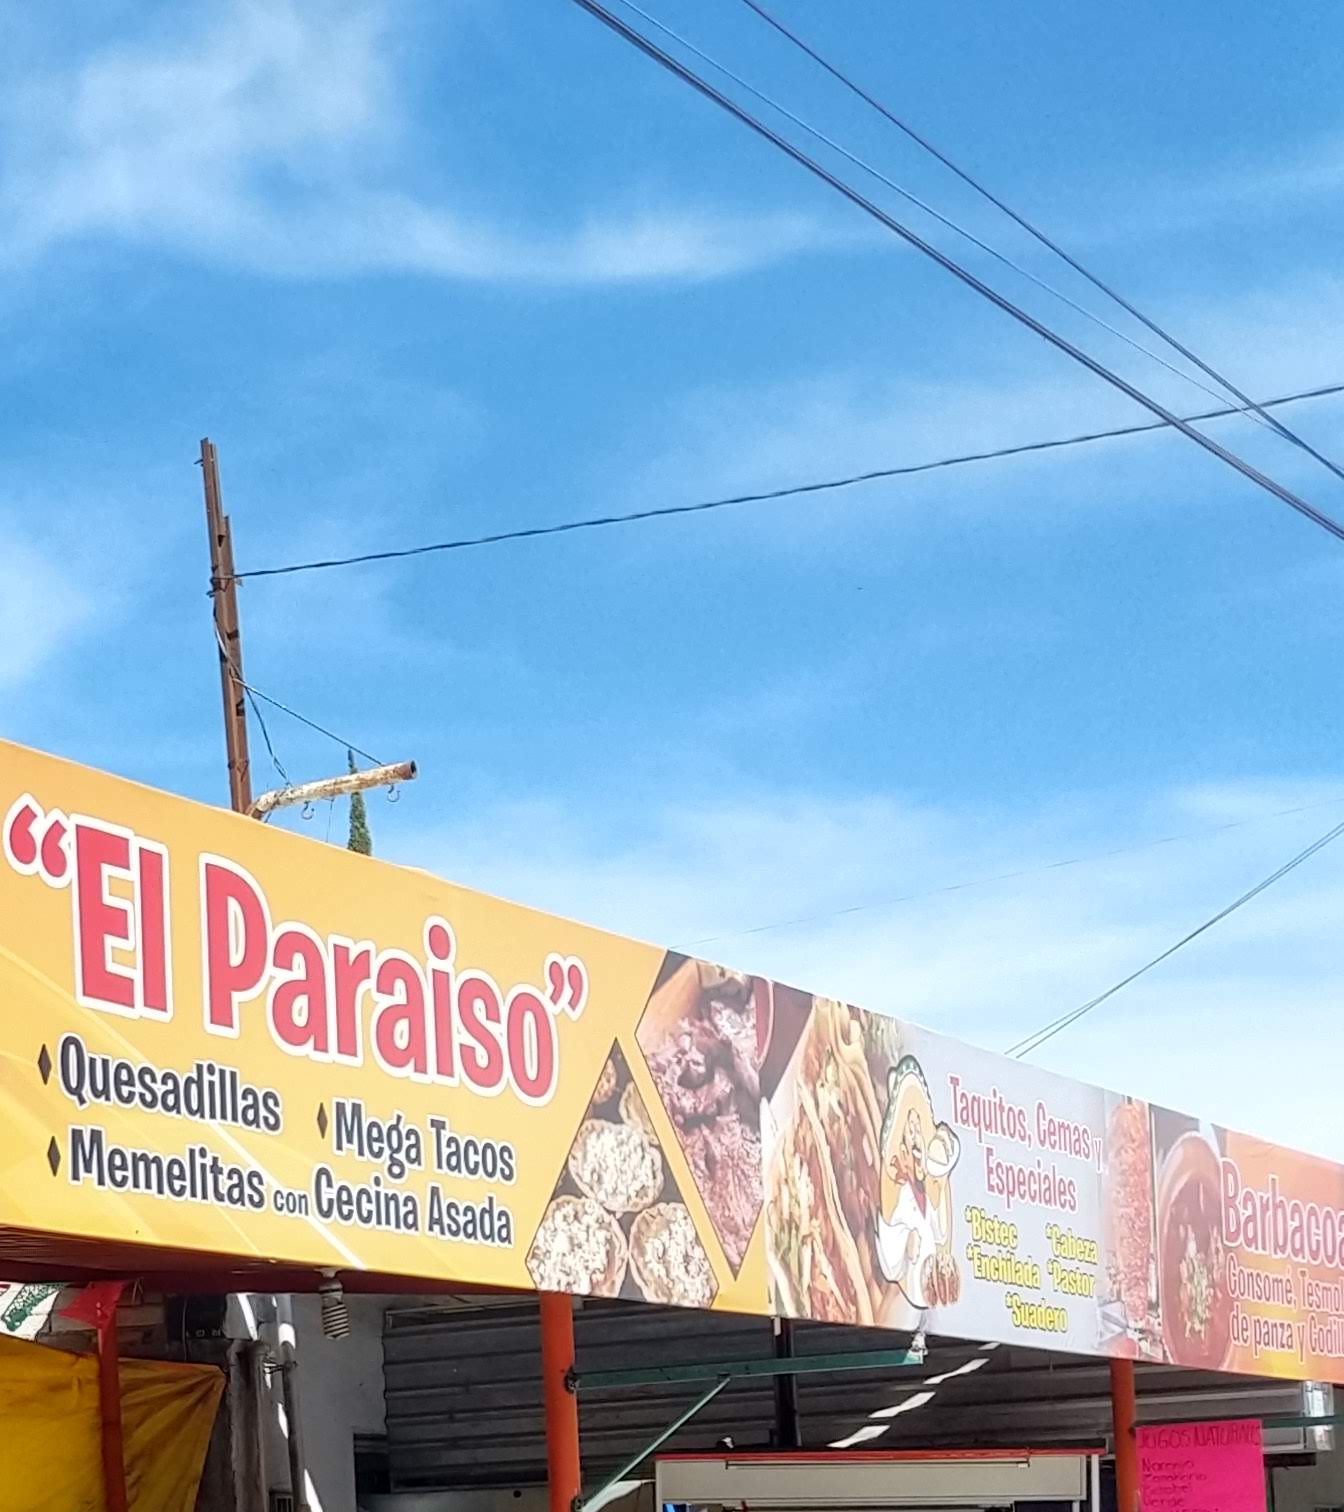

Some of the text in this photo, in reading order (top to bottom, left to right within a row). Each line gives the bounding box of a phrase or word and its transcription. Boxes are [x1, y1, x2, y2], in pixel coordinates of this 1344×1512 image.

[59, 1033, 282, 1134] Quesadillas
[948, 1075, 1032, 1149] Taquitos,
[334, 1100, 515, 1182] Mega Tacos
[985, 1146, 1077, 1212] Especiales
[68, 1127, 513, 1247] Memelitas con Cecina Asada
[1230, 1303, 1249, 1345] de
[1253, 1313, 1295, 1358] panza
[1297, 1322, 1305, 1364] y
